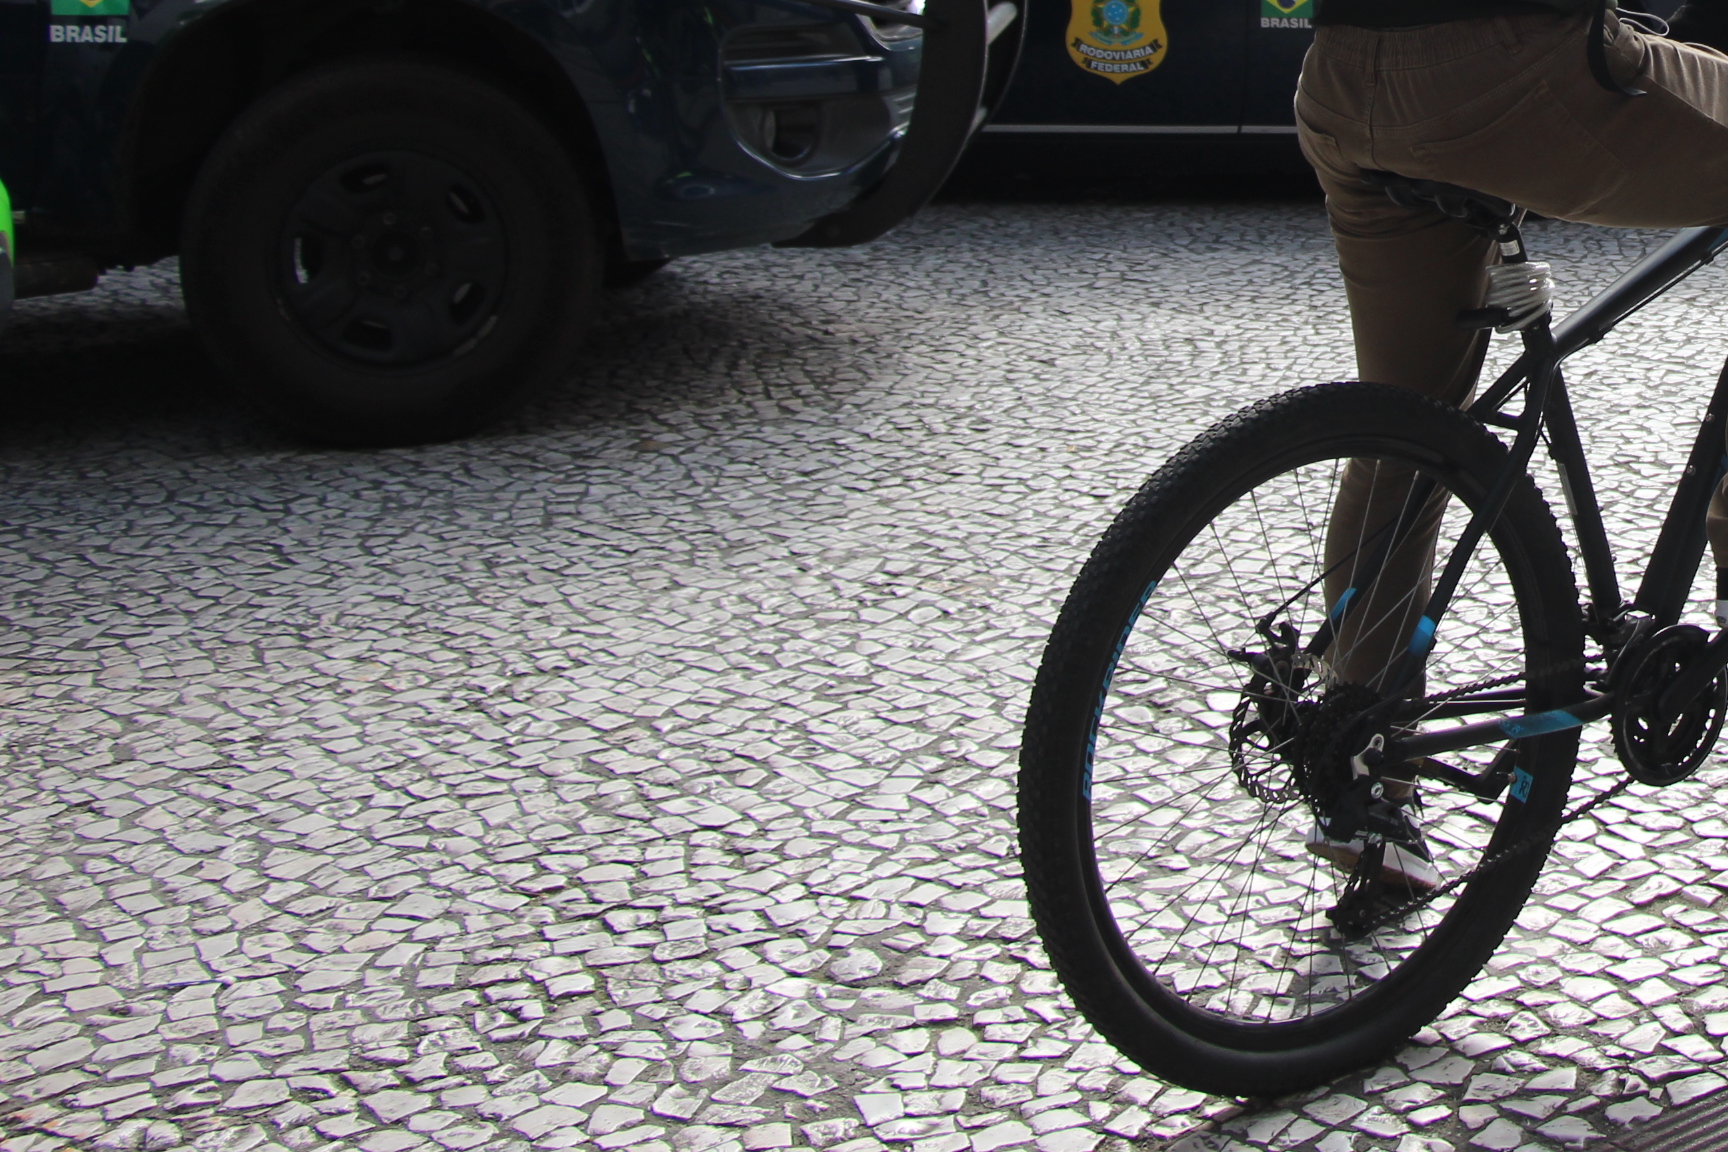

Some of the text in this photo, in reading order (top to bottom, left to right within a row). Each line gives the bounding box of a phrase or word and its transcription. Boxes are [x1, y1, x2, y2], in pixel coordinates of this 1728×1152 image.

[1260, 17, 1312, 28] BRASIL
[49, 25, 128, 43] BRASIL
[1090, 61, 1145, 73] FEDERAL
